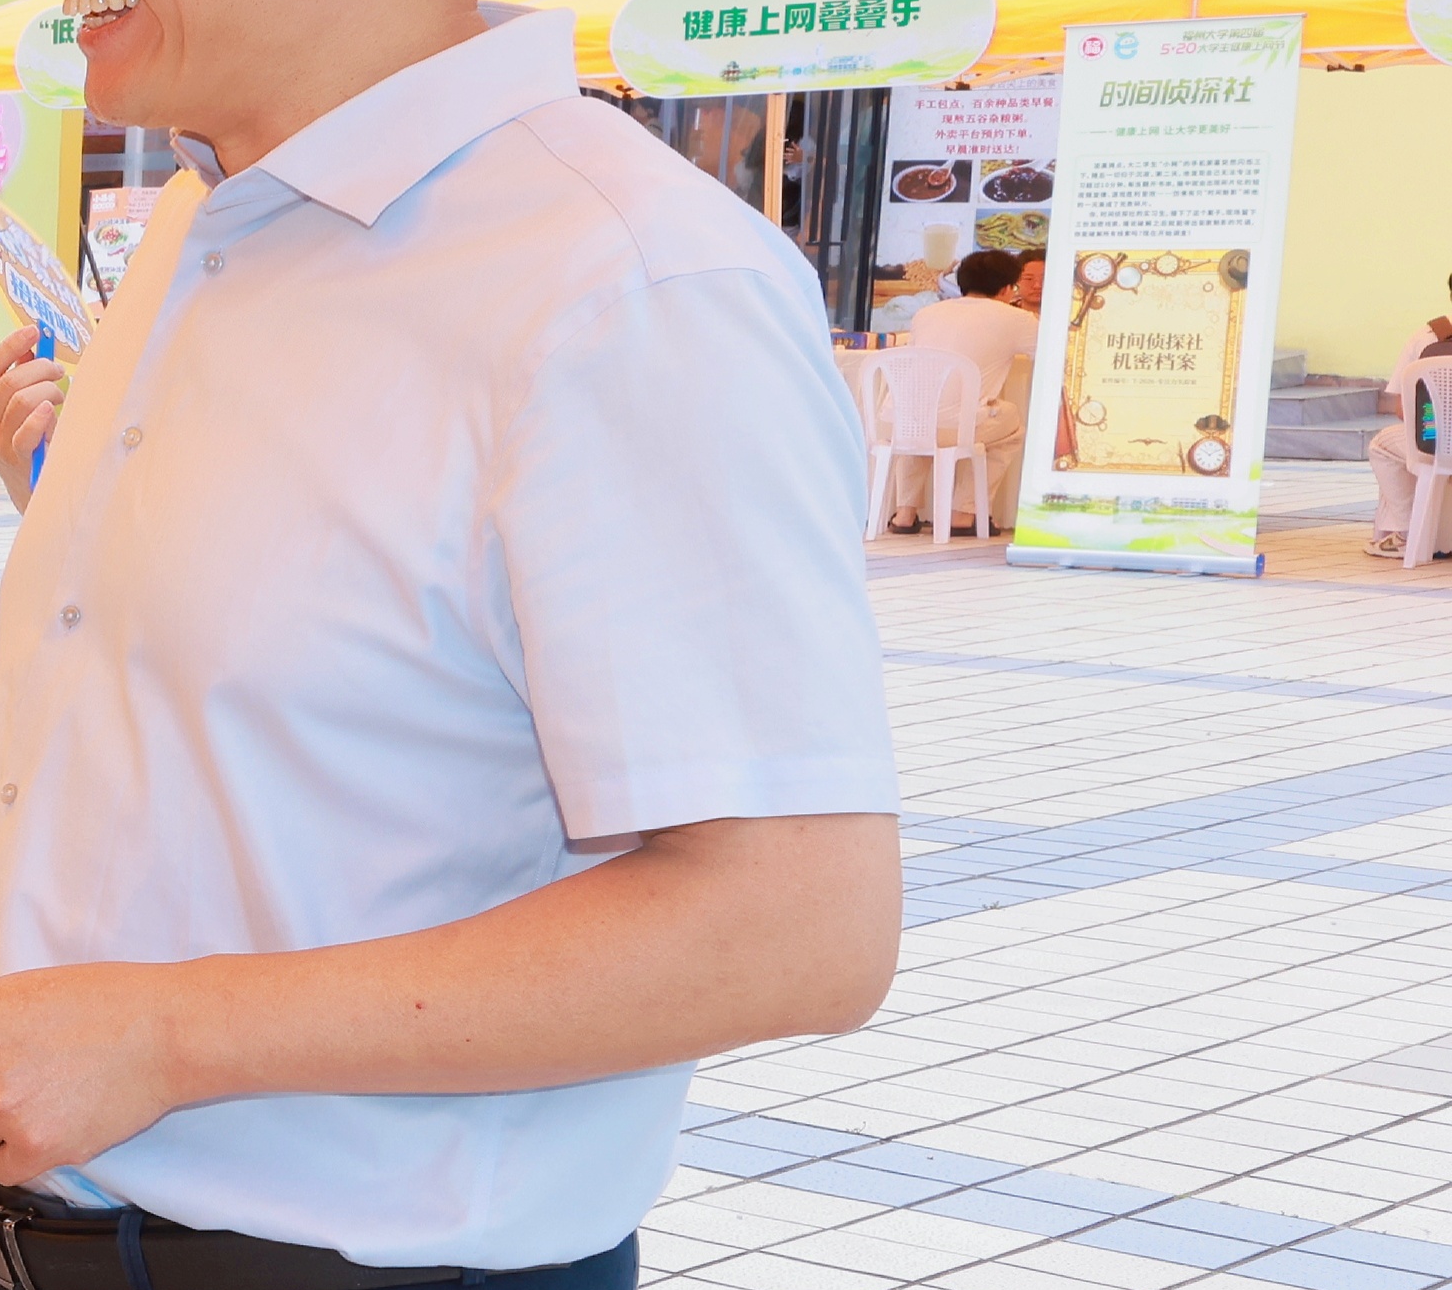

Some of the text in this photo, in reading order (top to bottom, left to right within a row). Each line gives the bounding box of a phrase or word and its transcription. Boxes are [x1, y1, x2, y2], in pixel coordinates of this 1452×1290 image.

[1099, 75, 1256, 108] 时间侦探社
[1106, 332, 1204, 351] 时间侦探社
[1112, 351, 1197, 371] 机密档案
